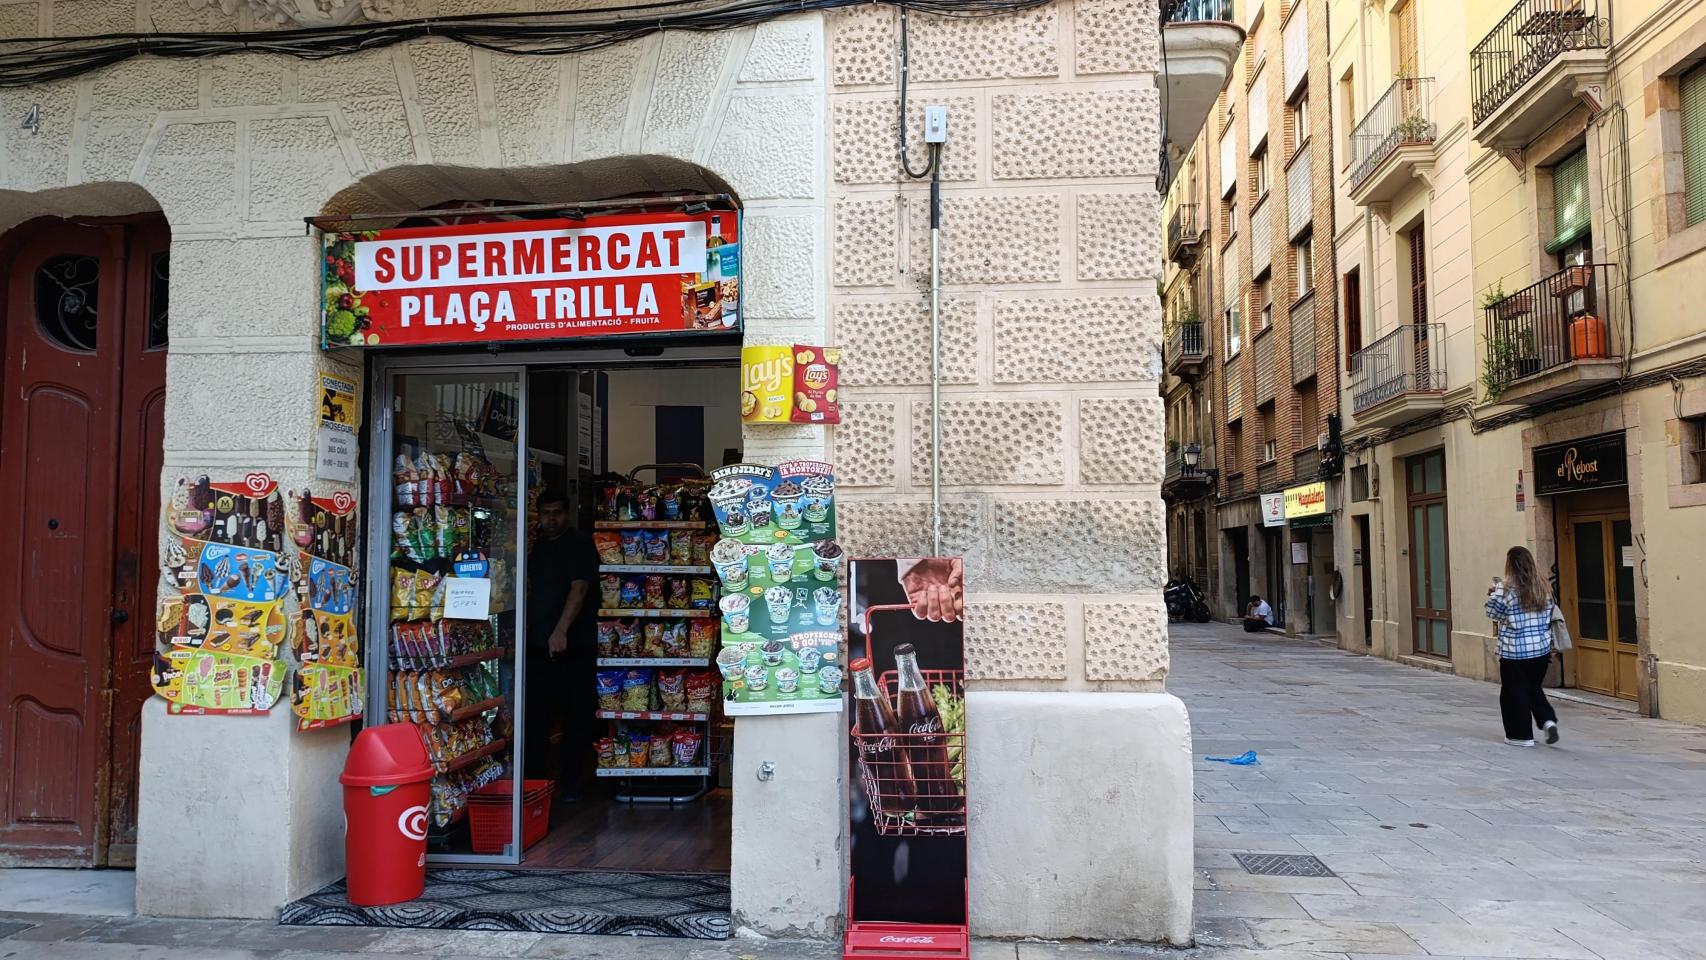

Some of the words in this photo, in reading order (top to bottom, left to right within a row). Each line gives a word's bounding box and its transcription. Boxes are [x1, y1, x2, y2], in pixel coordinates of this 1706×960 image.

[375, 230, 685, 283] SUPERMERCAT
[401, 290, 516, 332] PLAÇA
[531, 283, 659, 320] TRILLA
[506, 322, 555, 331] PRODUCTES
[558, 319, 621, 328] D'ALIMENTACIÓ
[630, 317, 660, 325] FRUITA
[743, 353, 793, 391] Lay's
[1557, 464, 1564, 476] el
[1565, 447, 1598, 481] Rebost
[460, 563, 484, 571] ABIERTO
